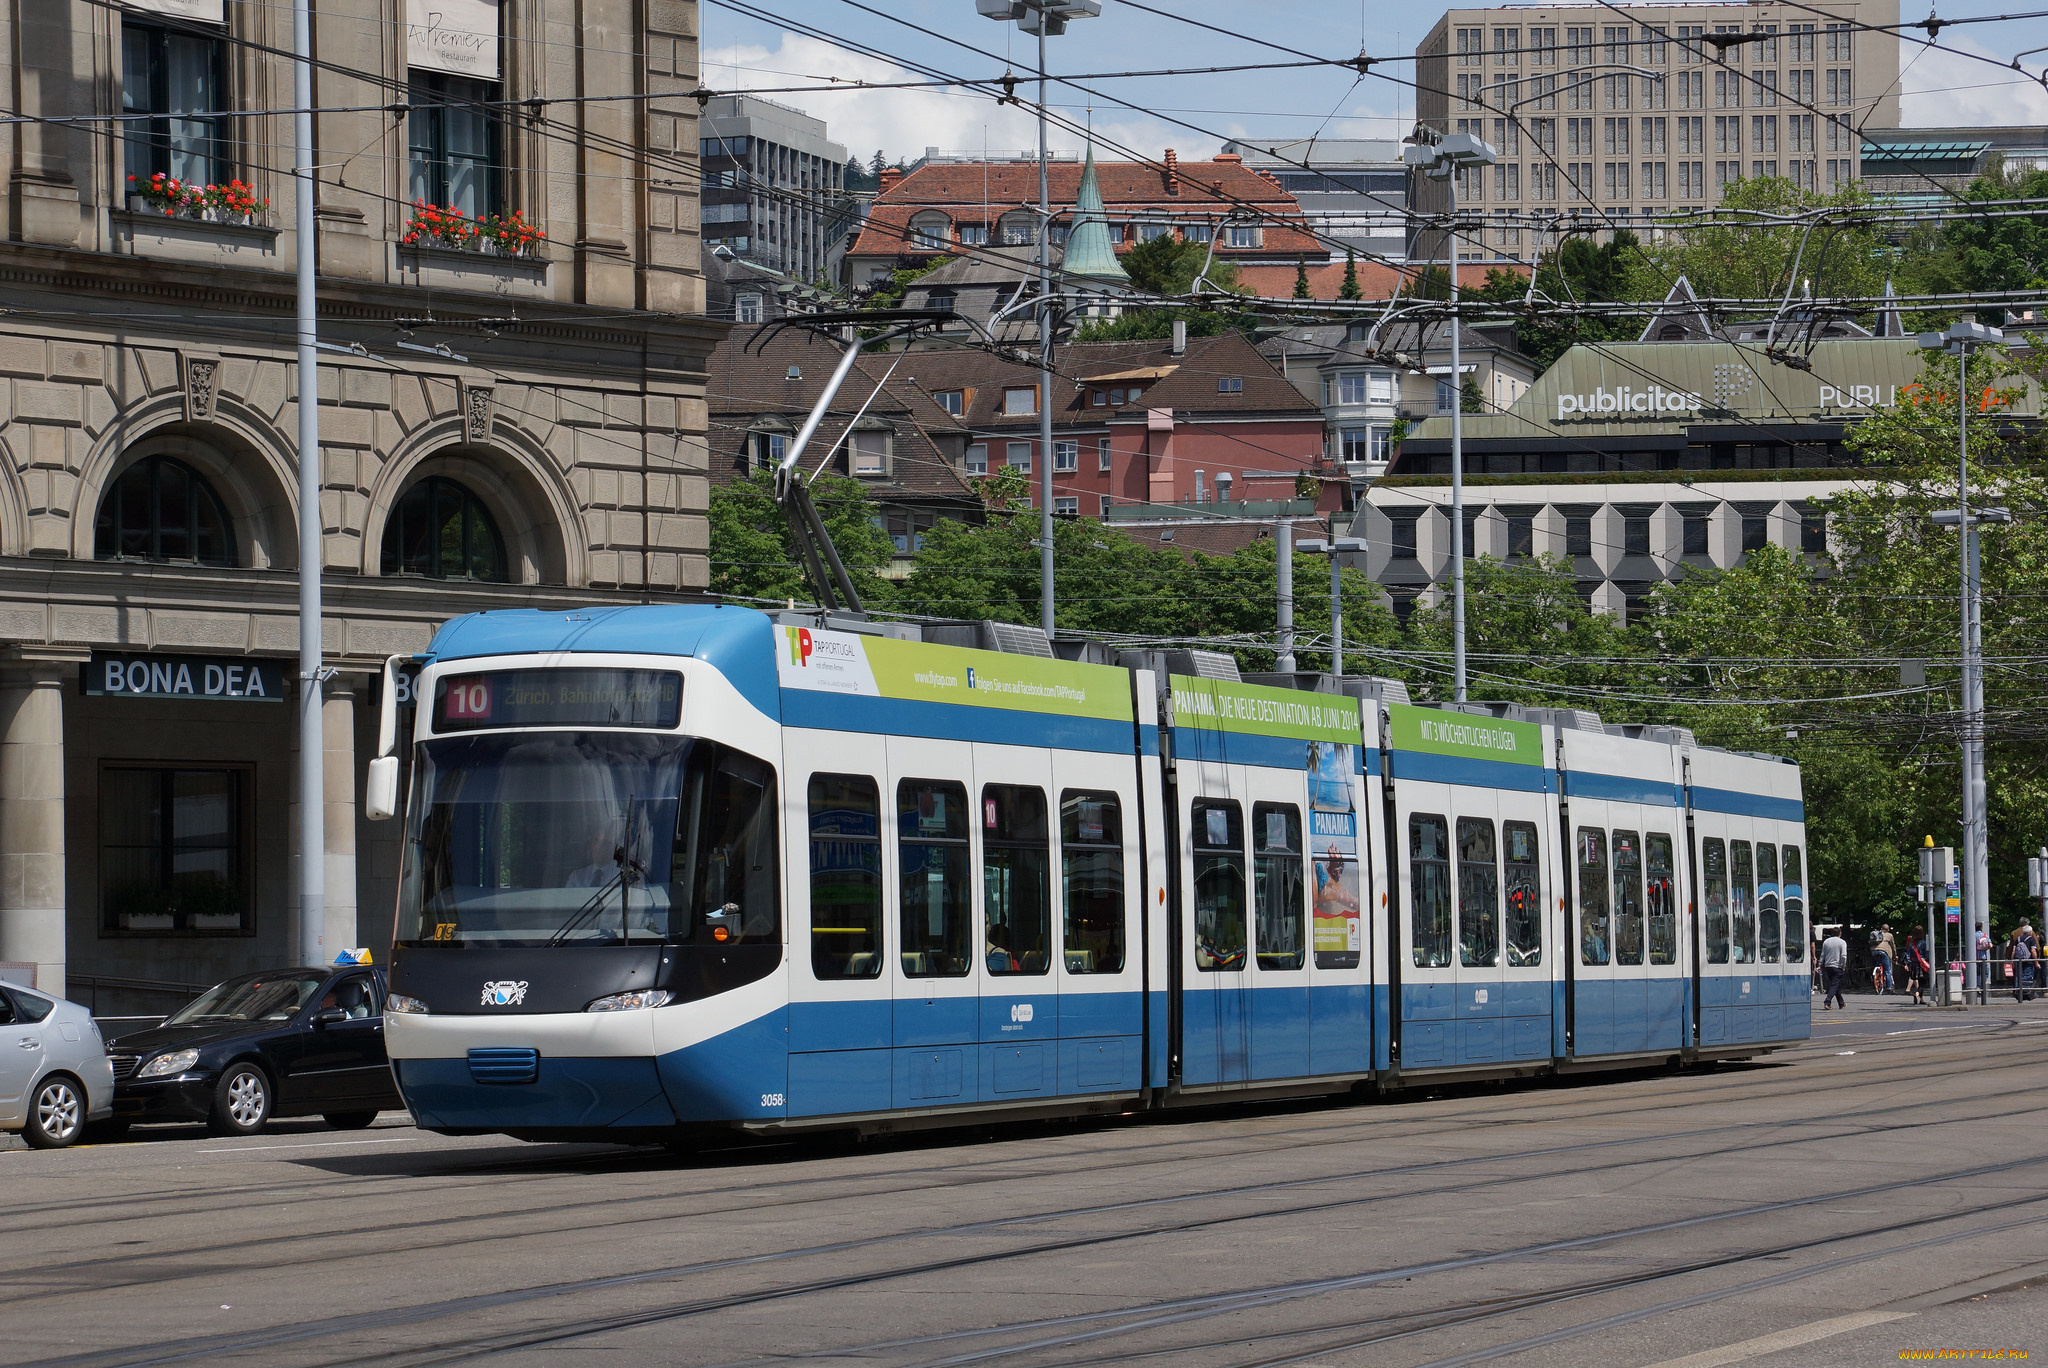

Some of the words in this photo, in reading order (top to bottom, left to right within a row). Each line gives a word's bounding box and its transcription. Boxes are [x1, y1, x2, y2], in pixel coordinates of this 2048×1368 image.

[441, 50, 476, 64] Restaurant
[1557, 385, 1701, 420] publicitas
[785, 626, 813, 668] TAP
[105, 660, 194, 694] BONA
[204, 664, 266, 697] DEA
[914, 670, 958, 689] www.flytap.com
[977, 675, 993, 694] folgen
[993, 678, 1002, 692] Sie
[1002, 682, 1012, 693] uns
[1012, 680, 1020, 694] auf
[1020, 681, 1085, 704] facebook.com/TAPPortugal
[453, 684, 488, 713] 10
[1174, 690, 1218, 720] PANAMA,
[1218, 695, 1233, 718] DIE
[1233, 698, 1257, 721] NEUE
[1257, 700, 1310, 727] DESTINATION
[1311, 706, 1322, 727] AB
[1323, 708, 1341, 729] JUNI
[1341, 710, 1359, 731] 2014
[1420, 719, 1433, 740] MIT
[1433, 722, 1438, 741] 3
[1438, 720, 1492, 748] WÖCHENTLICHEN
[1492, 727, 1516, 751] FLÜGEN
[985, 803, 996, 824] 10
[1315, 813, 1350, 836] PANAMA
[436, 926, 453, 939] 09
[341, 952, 362, 961] TAXI
[761, 1093, 783, 1106] 3058
